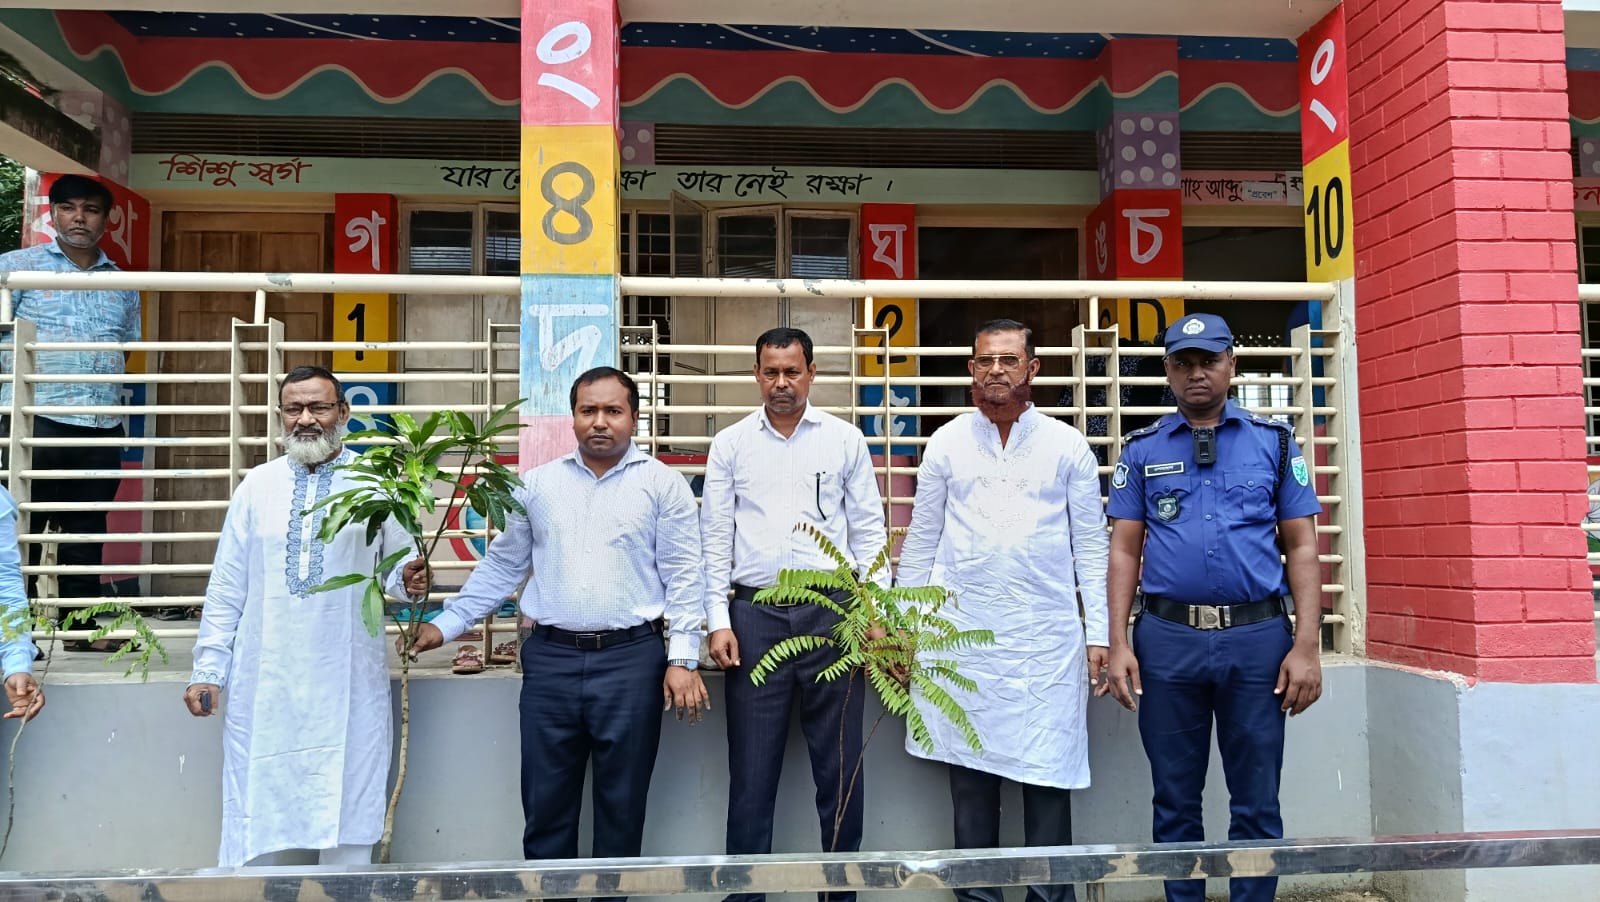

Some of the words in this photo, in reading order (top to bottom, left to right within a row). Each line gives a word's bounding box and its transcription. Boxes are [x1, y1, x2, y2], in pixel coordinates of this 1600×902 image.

[159, 152, 246, 187] শিশু
[248, 157, 312, 186] স্বর্গ
[440, 165, 502, 188] যার
[677, 170, 732, 193] তার
[735, 166, 794, 199] নেই
[806, 173, 872, 195] রক্ষা
[539, 161, 595, 245] 8
[1306, 177, 1344, 266] 10
[345, 209, 386, 272] গ
[868, 223, 908, 279] ঘ
[1121, 208, 1170, 264] চ
[347, 303, 366, 362] 1
[875, 304, 908, 364] 2
